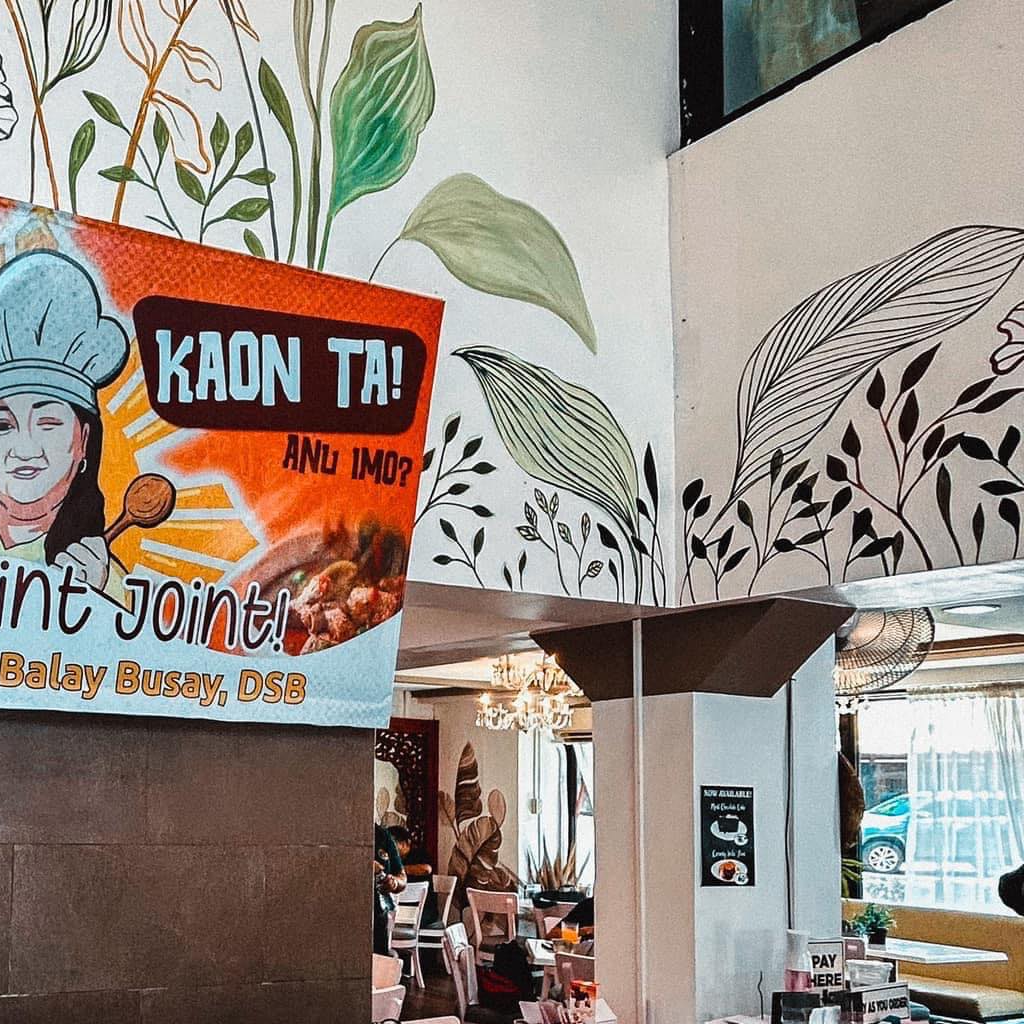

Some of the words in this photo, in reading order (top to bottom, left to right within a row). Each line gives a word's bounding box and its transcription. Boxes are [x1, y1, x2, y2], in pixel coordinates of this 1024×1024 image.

[155, 329, 301, 406] KAON
[327, 336, 404, 408] TA!
[282, 433, 339, 475] ANU
[351, 446, 413, 487] IMO?
[114, 660, 229, 707] Busay,
[237, 668, 308, 705] DSB
[811, 953, 837, 969] PAY
